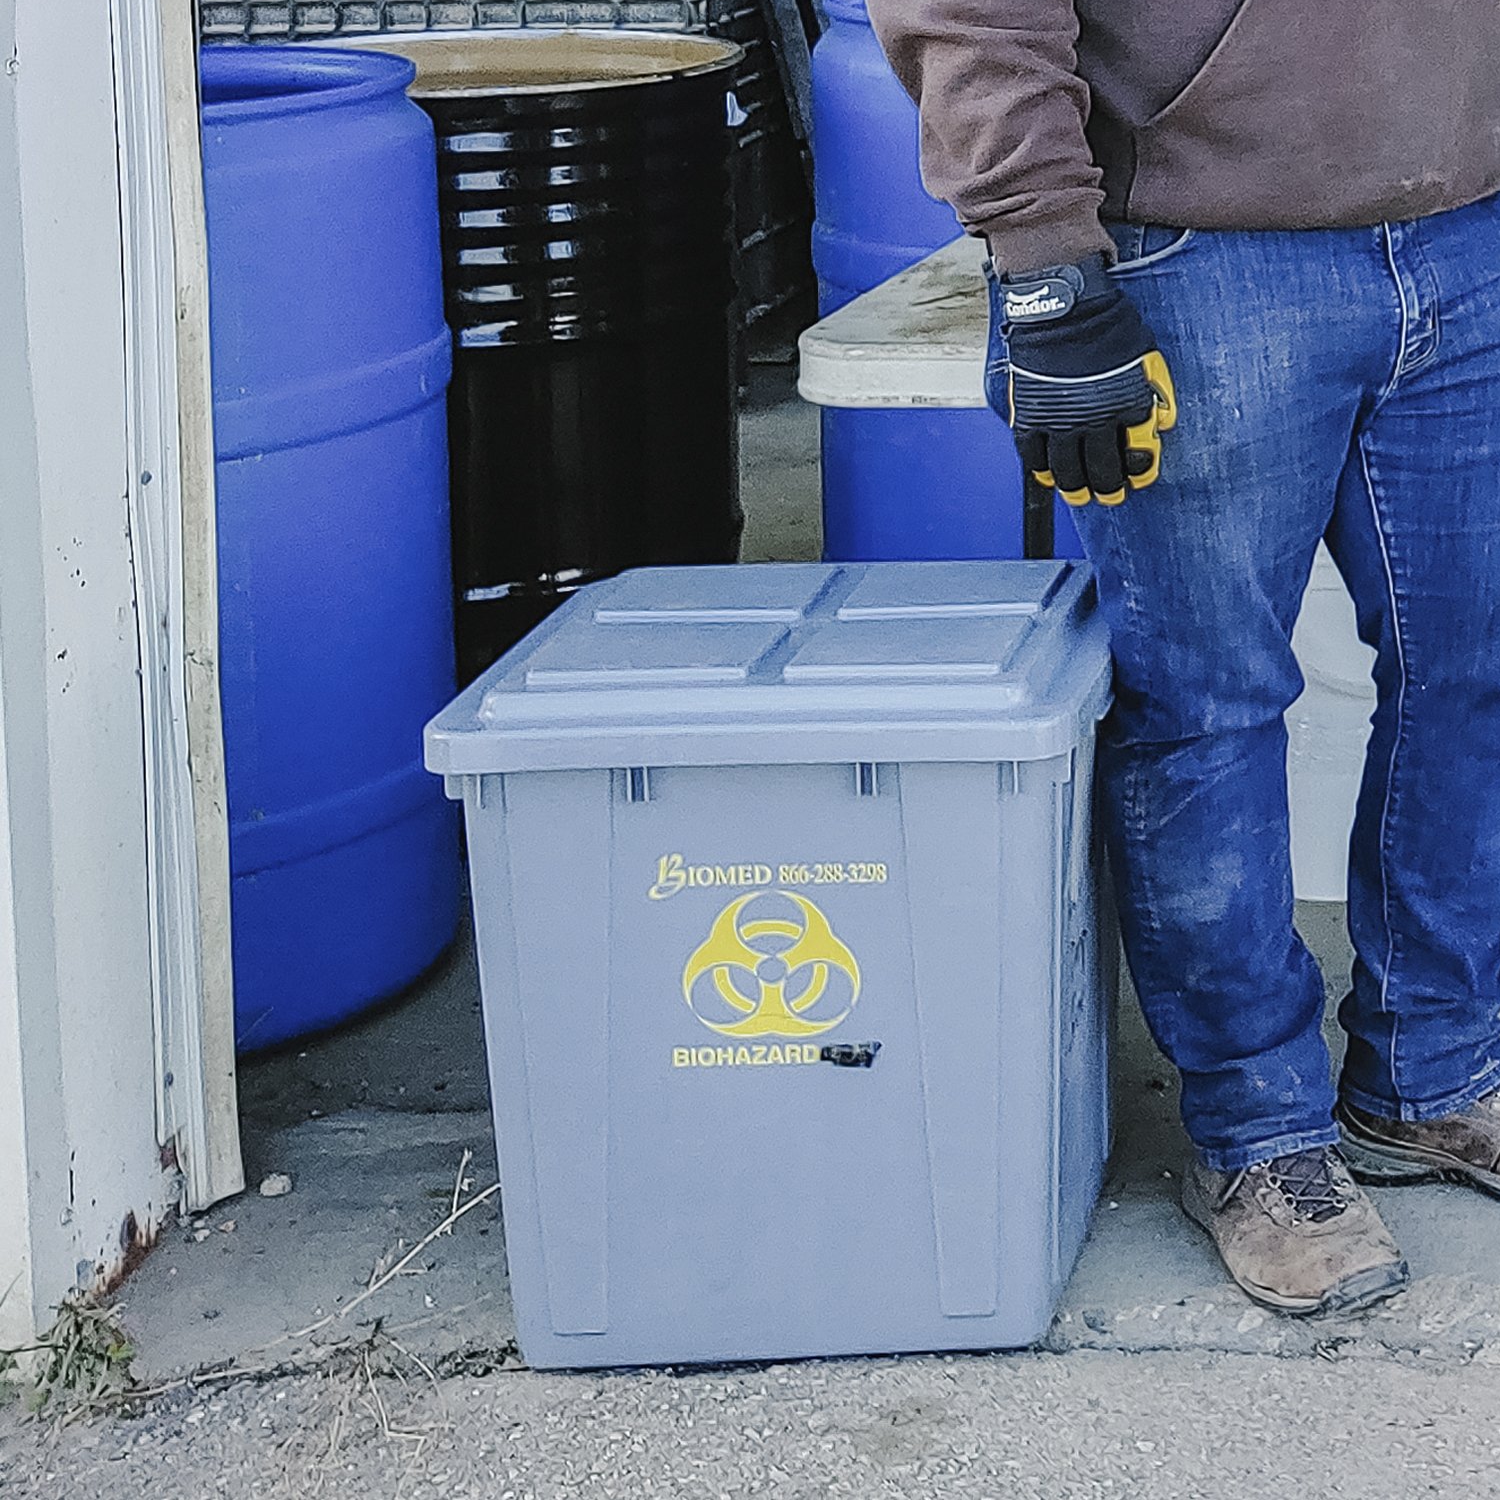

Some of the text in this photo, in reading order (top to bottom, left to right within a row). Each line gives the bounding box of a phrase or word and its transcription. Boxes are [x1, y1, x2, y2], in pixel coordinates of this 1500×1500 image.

[1006, 297, 1060, 318] Condor
[778, 862, 888, 884] 866-288-3298
[672, 1043, 822, 1068] BIOHAZARD
